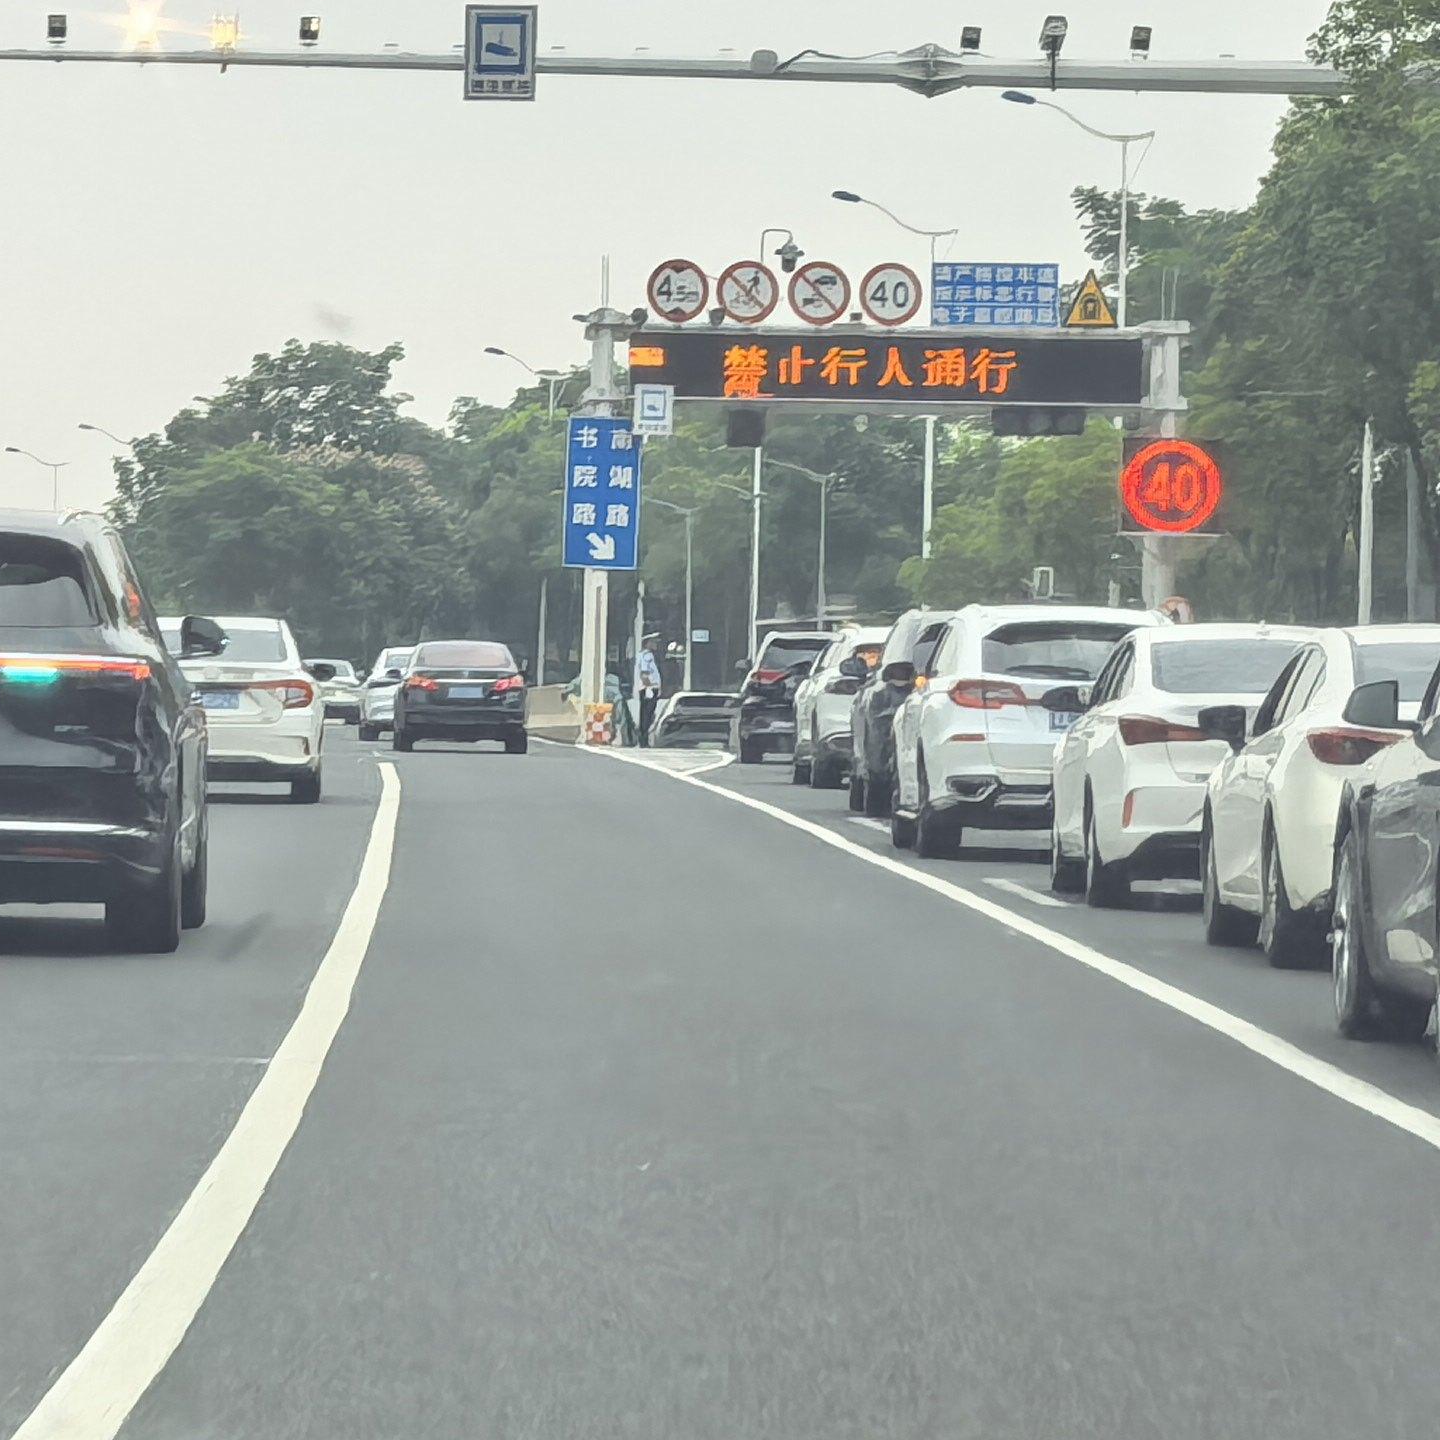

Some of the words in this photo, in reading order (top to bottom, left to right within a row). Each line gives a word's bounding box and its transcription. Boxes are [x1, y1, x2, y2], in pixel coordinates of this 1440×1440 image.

[870, 280, 910, 308] 40
[571, 426, 599, 526] 书院路
[605, 428, 633, 527] 南湖路
[1144, 461, 1201, 513] 40
